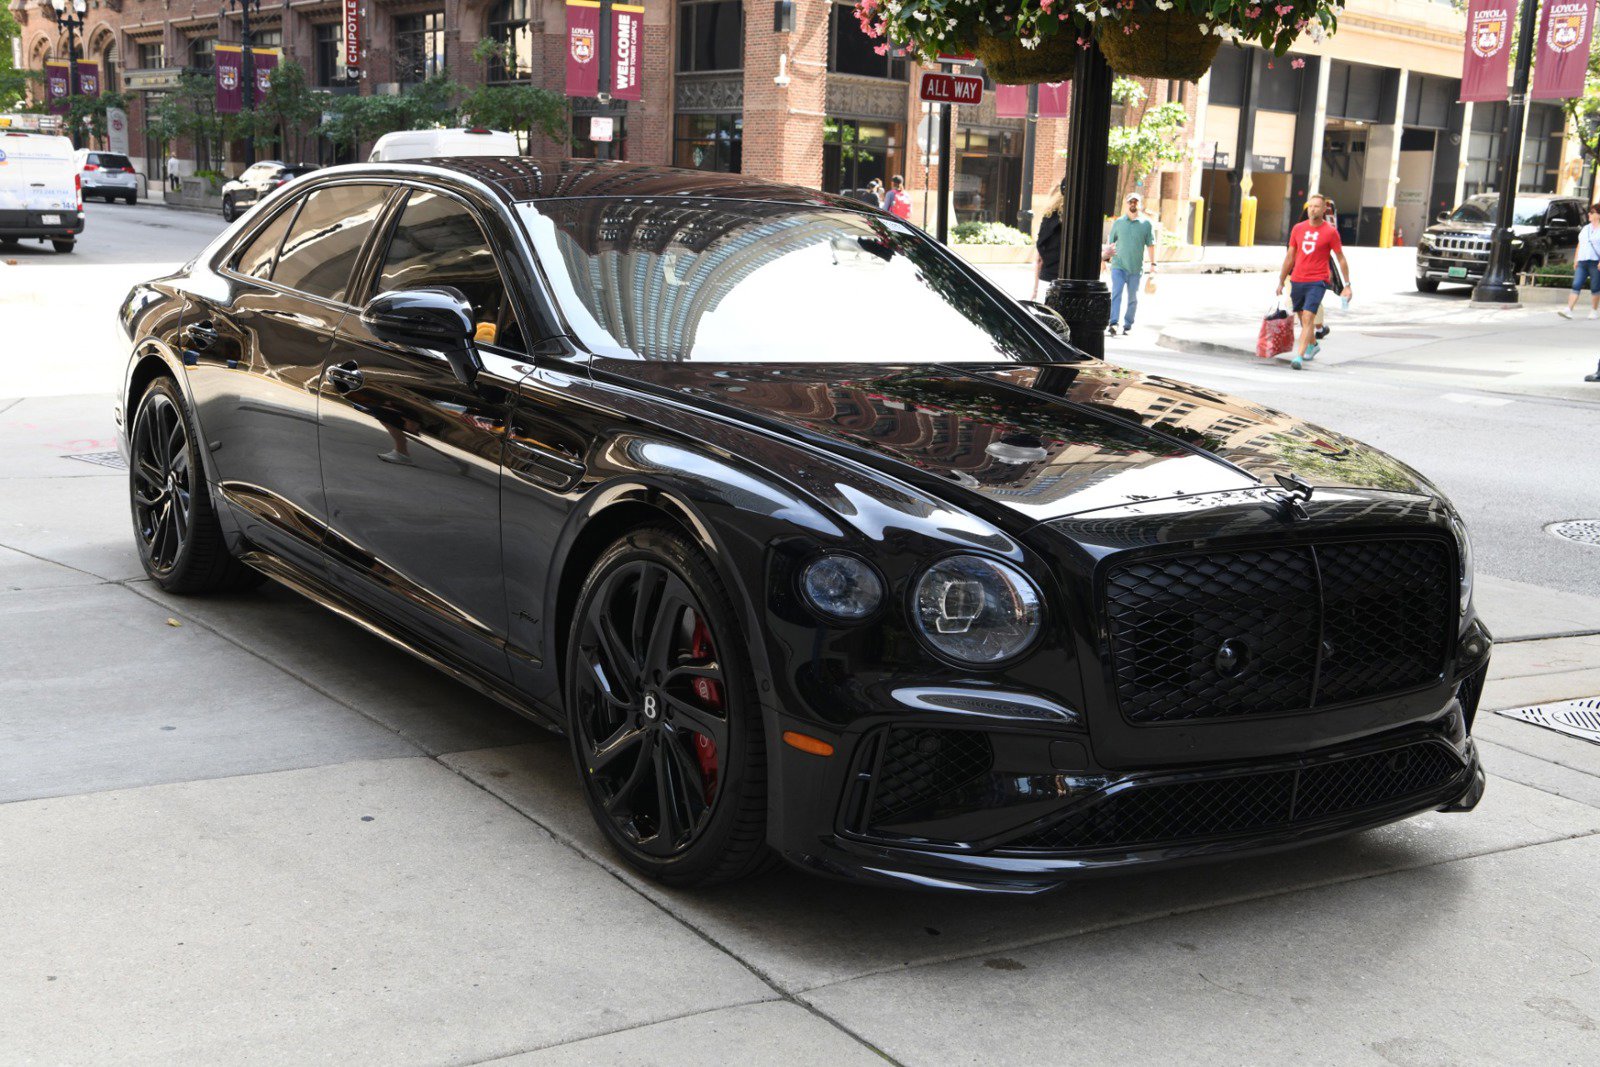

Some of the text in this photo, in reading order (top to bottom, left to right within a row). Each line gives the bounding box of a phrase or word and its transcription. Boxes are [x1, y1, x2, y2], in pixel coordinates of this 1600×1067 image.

[1474, 9, 1507, 19] LOYOLA
[1551, 3, 1588, 13] LOYOLA
[348, 1, 357, 63] CHIPOTLE
[571, 27, 594, 35] LOYOLA
[617, 14, 630, 89] WELCOME
[926, 79, 977, 99] ALL WAY
[645, 696, 656, 719] B
